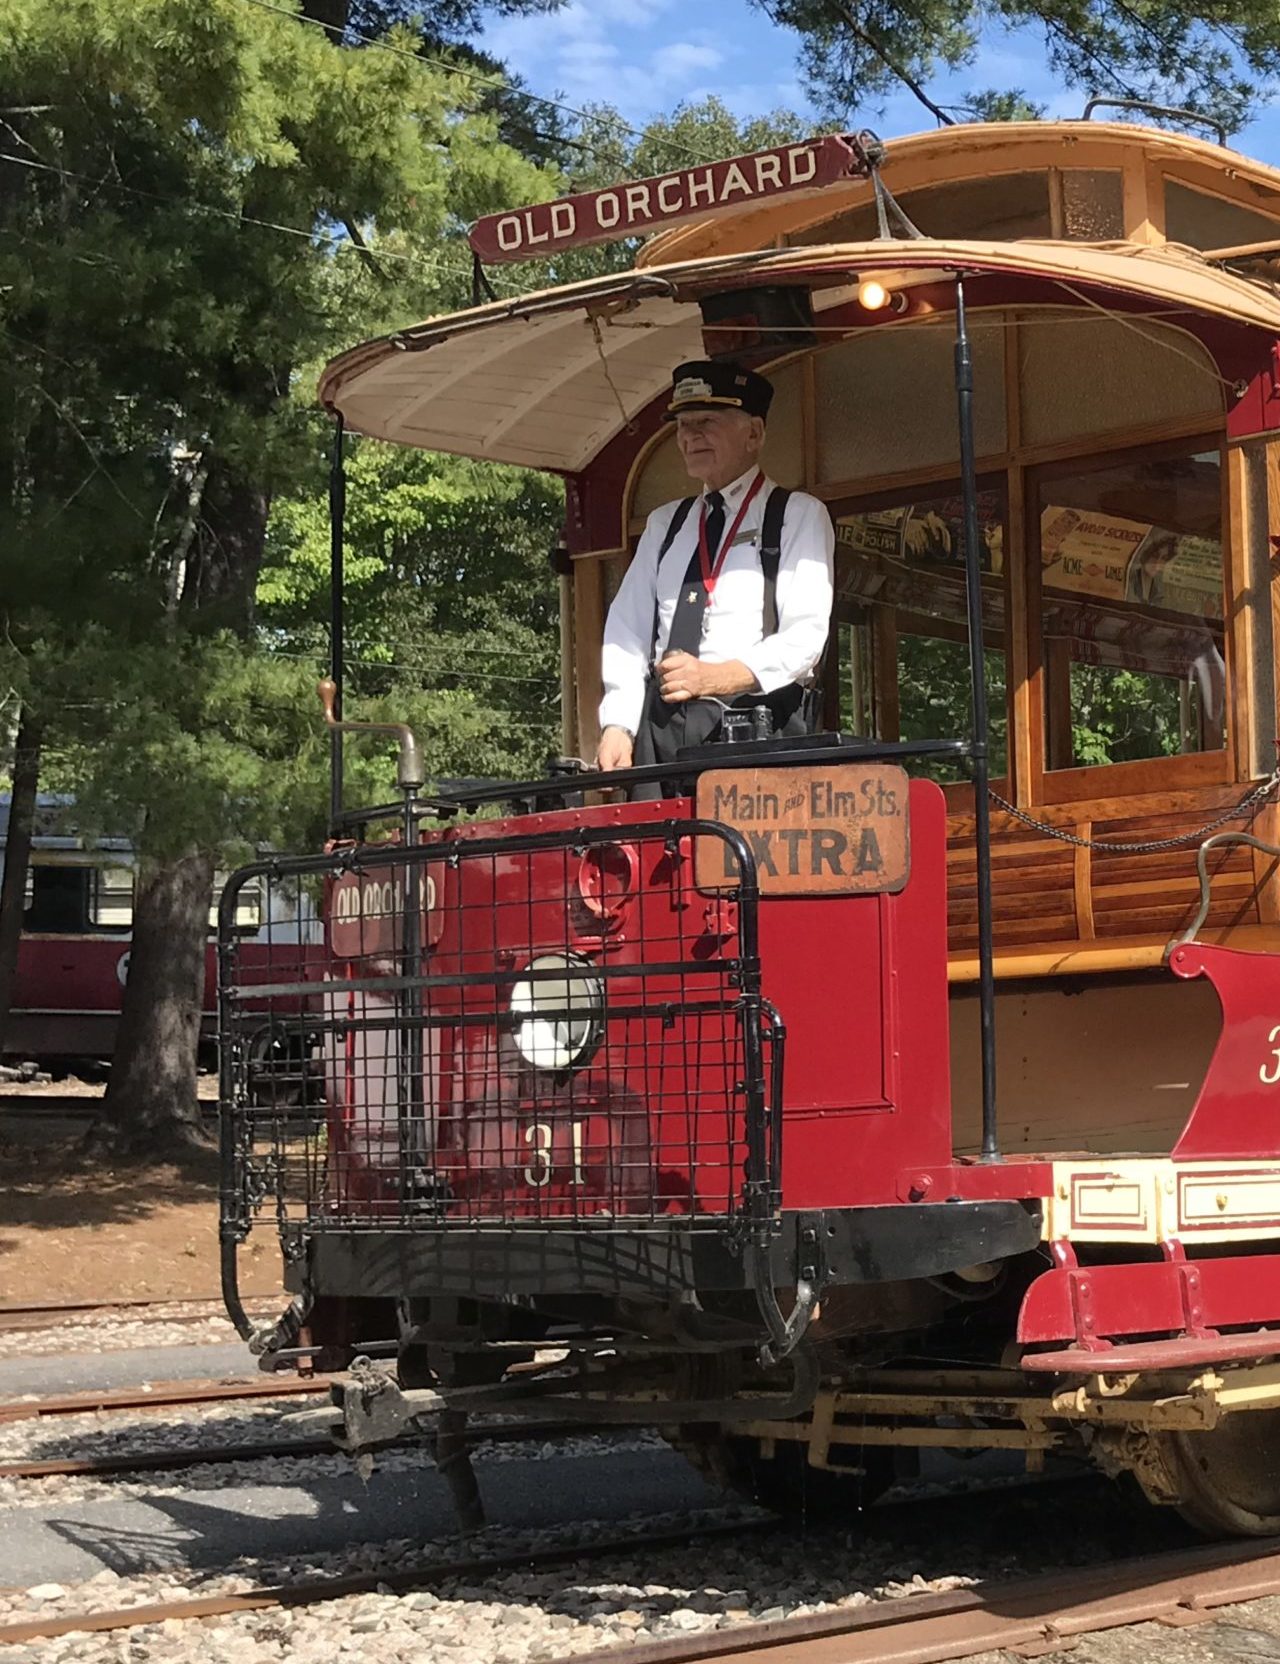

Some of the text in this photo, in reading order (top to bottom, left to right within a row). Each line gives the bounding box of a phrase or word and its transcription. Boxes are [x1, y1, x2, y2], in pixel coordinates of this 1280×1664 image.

[497, 146, 818, 251] OLD ORCHARD
[1075, 521, 1106, 535] AVOID
[1063, 556, 1123, 582] ACME LIME
[714, 779, 900, 821] Main AND Elm Sts.
[337, 886, 361, 925] OLD
[523, 1121, 585, 1188] 31
